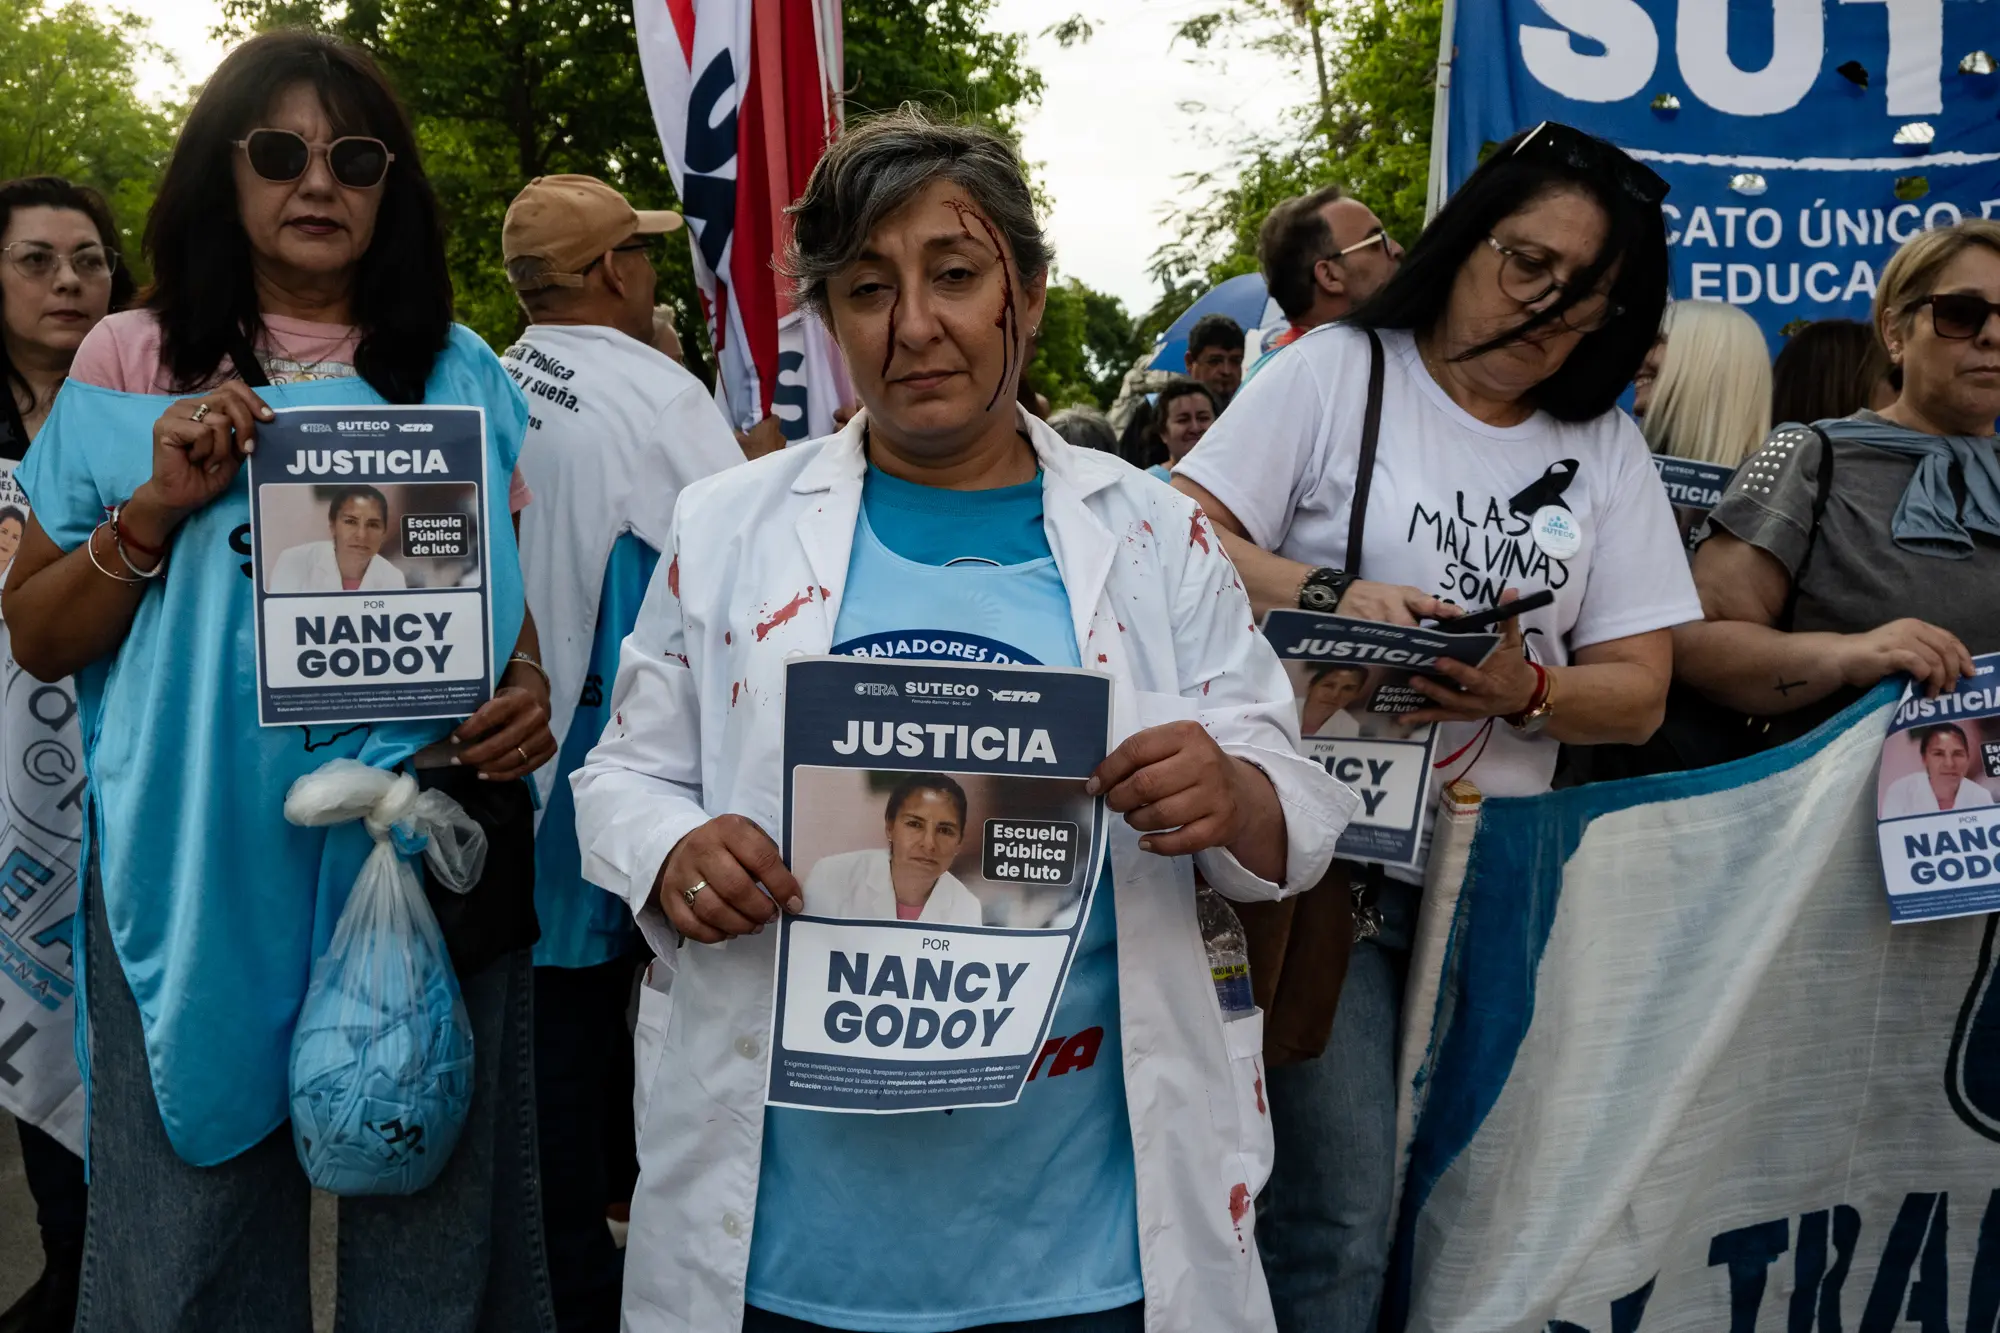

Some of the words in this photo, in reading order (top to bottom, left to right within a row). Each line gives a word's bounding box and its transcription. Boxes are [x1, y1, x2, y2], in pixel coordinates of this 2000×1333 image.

[1662, 203, 1783, 248] CATO
[1801, 199, 1962, 246] ÚNICO
[531, 380, 579, 413] sueña.
[337, 421, 390, 431] SUTECO
[286, 449, 449, 475] JUSTICIA
[408, 517, 462, 529] Escuela
[1456, 490, 1531, 536] LAS
[409, 529, 461, 541] Pública
[1408, 502, 1569, 589] MALVINAS
[412, 543, 429, 555] de
[432, 543, 459, 555] luto
[1439, 563, 1507, 607] SON
[363, 601, 385, 609] POR
[295, 612, 452, 645] NANCY
[1350, 626, 1405, 638] SUTECO
[297, 645, 453, 678] GODOY
[842, 639, 987, 662] BAJADORES
[905, 682, 979, 697] SUTECO
[832, 720, 1057, 764] JUSTICIA
[1308, 754, 1395, 786] NCY
[993, 824, 1069, 842] Escuela
[993, 841, 1066, 862] Pública
[995, 862, 1020, 877] de
[1024, 863, 1061, 880] luto
[922, 938, 950, 951] POR
[827, 950, 1030, 1003] NANCY
[824, 1000, 1015, 1049] GODOY
[1026, 1026, 1104, 1082] TA
[784, 1060, 810, 1068] Exigimos
[811, 1063, 846, 1072] investigación
[789, 1080, 821, 1090] Educación
